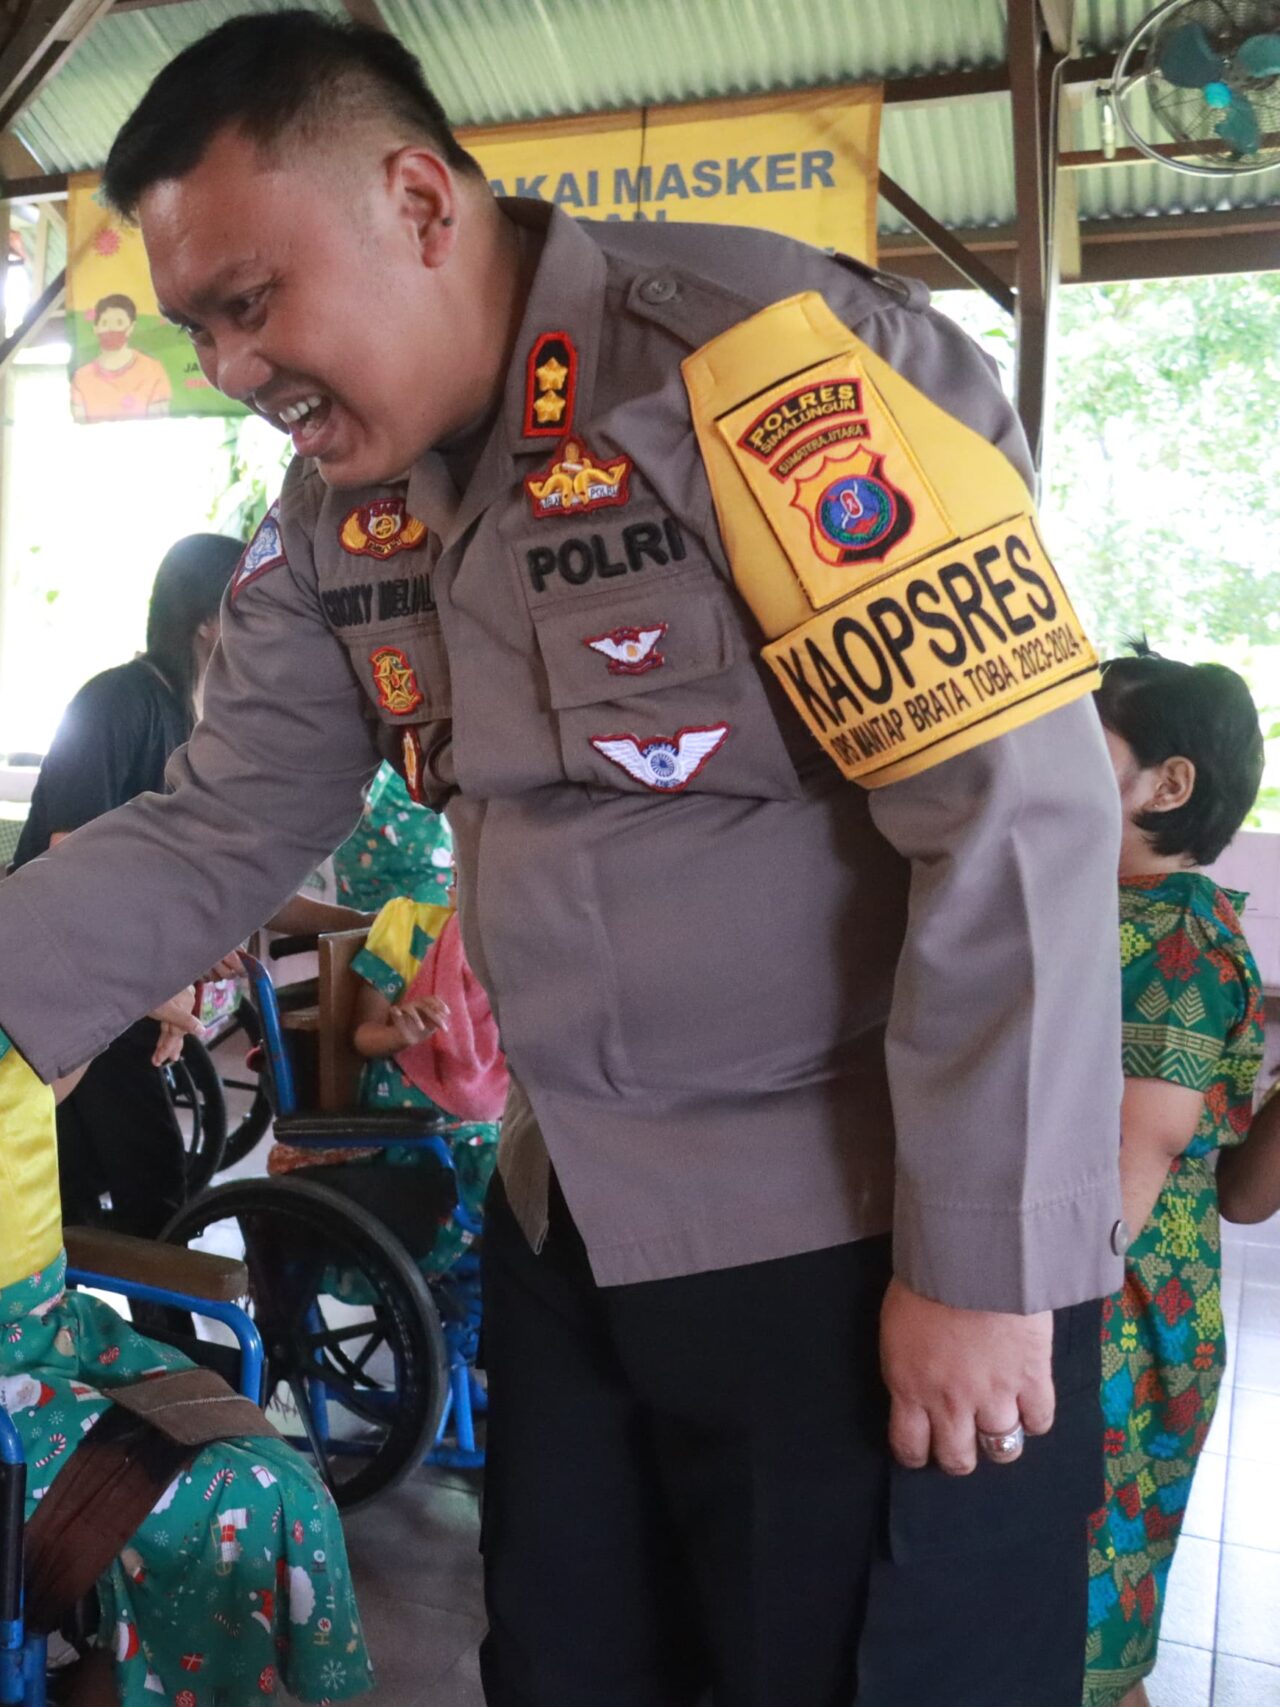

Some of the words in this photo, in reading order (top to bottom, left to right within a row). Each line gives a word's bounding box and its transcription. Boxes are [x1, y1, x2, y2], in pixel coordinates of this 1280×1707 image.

[613, 150, 836, 204] MASKER
[750, 384, 854, 444] POLRES
[761, 399, 856, 454] SIMALUNGUN
[526, 517, 687, 593] POLRI
[776, 533, 1059, 733] KAOPSRES
[848, 708, 906, 758] MANTAP
[904, 678, 971, 733] BRATA
[963, 655, 1019, 702] TOBA
[1011, 623, 1083, 681] 2023-2024
